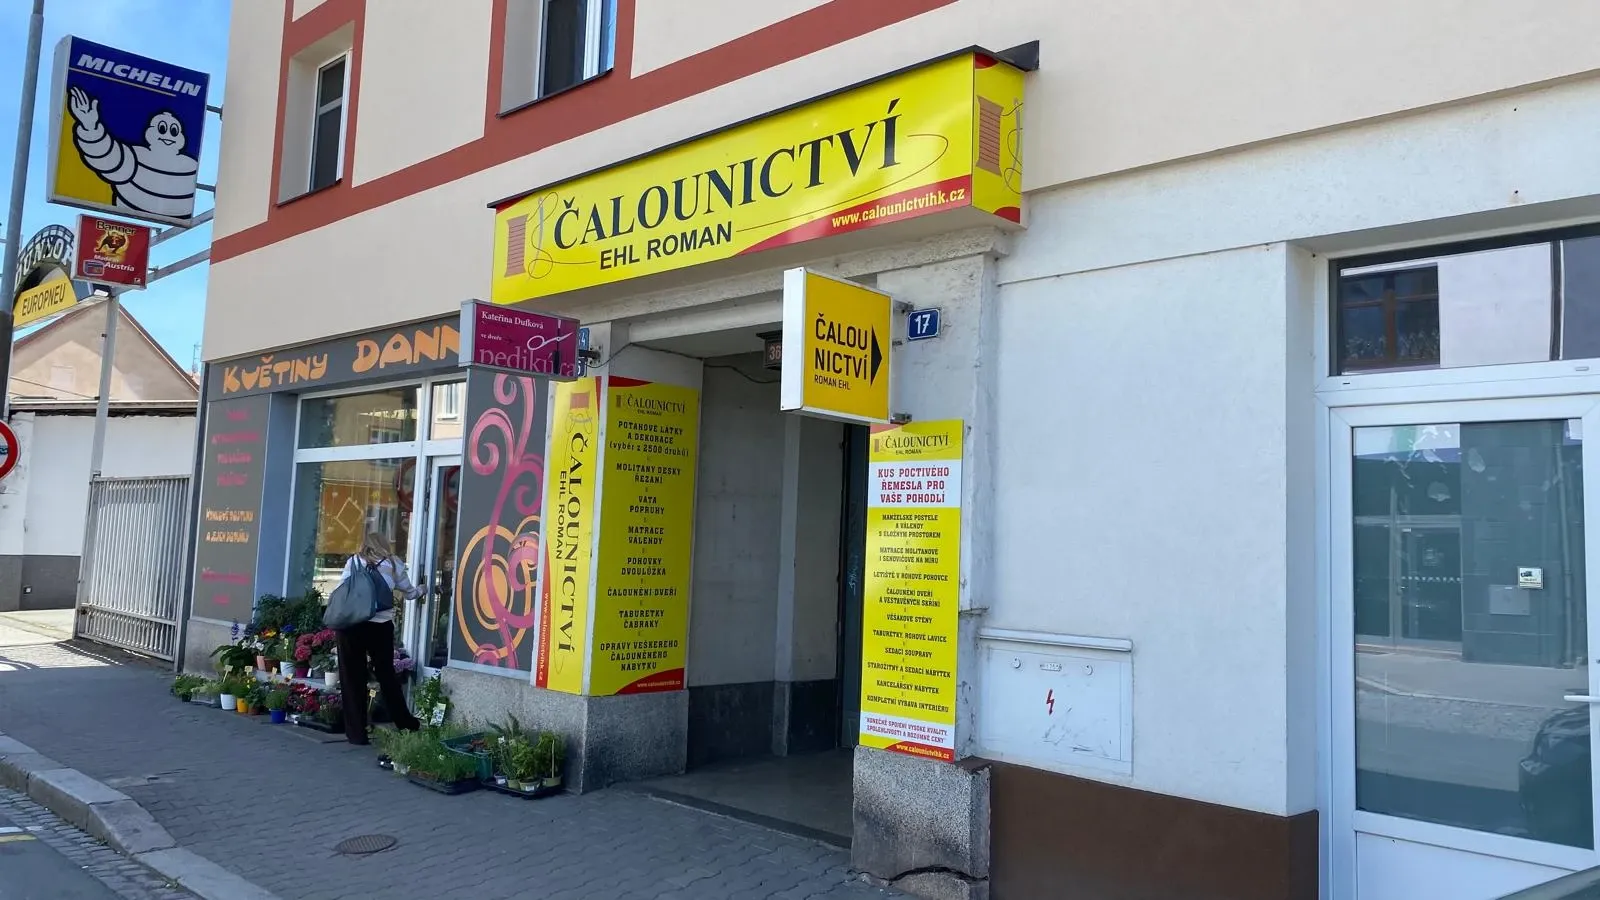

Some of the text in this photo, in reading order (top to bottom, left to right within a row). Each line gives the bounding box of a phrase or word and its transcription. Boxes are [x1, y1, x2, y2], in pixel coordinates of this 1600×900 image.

[77, 53, 201, 97] MICHELIN
[553, 98, 902, 250] ČALOUNICTVÍ
[831, 186, 966, 230] www.calounictvihk.cz
[96, 220, 137, 235] Banner
[599, 221, 733, 271] EHL ROMAN
[105, 262, 135, 272] Austria
[22, 283, 66, 316] EUROPNEU
[481, 311, 544, 330] Kateřina Dufková
[914, 313, 932, 335] 17
[815, 313, 868, 351] ČALOU
[480, 346, 576, 377] pedikúra
[815, 348, 868, 380] NICTVÍ
[814, 374, 850, 391] ROMAN EHL
[634, 433, 674, 444] DEKORACE
[885, 432, 949, 449] ČALOUNICTVÍ
[643, 444, 663, 454] 2500
[616, 463, 681, 476] MOLITANY DESKY
[878, 465, 950, 478] KUS POCTIVÉHO
[882, 479, 945, 491] ŘEMESLA PRO
[638, 495, 657, 504] VATA
[880, 490, 945, 503] VAŠE POHODLÍ
[555, 470, 567, 560] EHL ROMAN
[629, 505, 665, 515] POPRUHY
[628, 525, 664, 535] MATRACE
[557, 431, 589, 653] ČALOUNICTVÍ
[627, 557, 662, 566] POHOVKY
[619, 609, 665, 619] TABURETKY
[600, 641, 631, 651] OPRAVY
